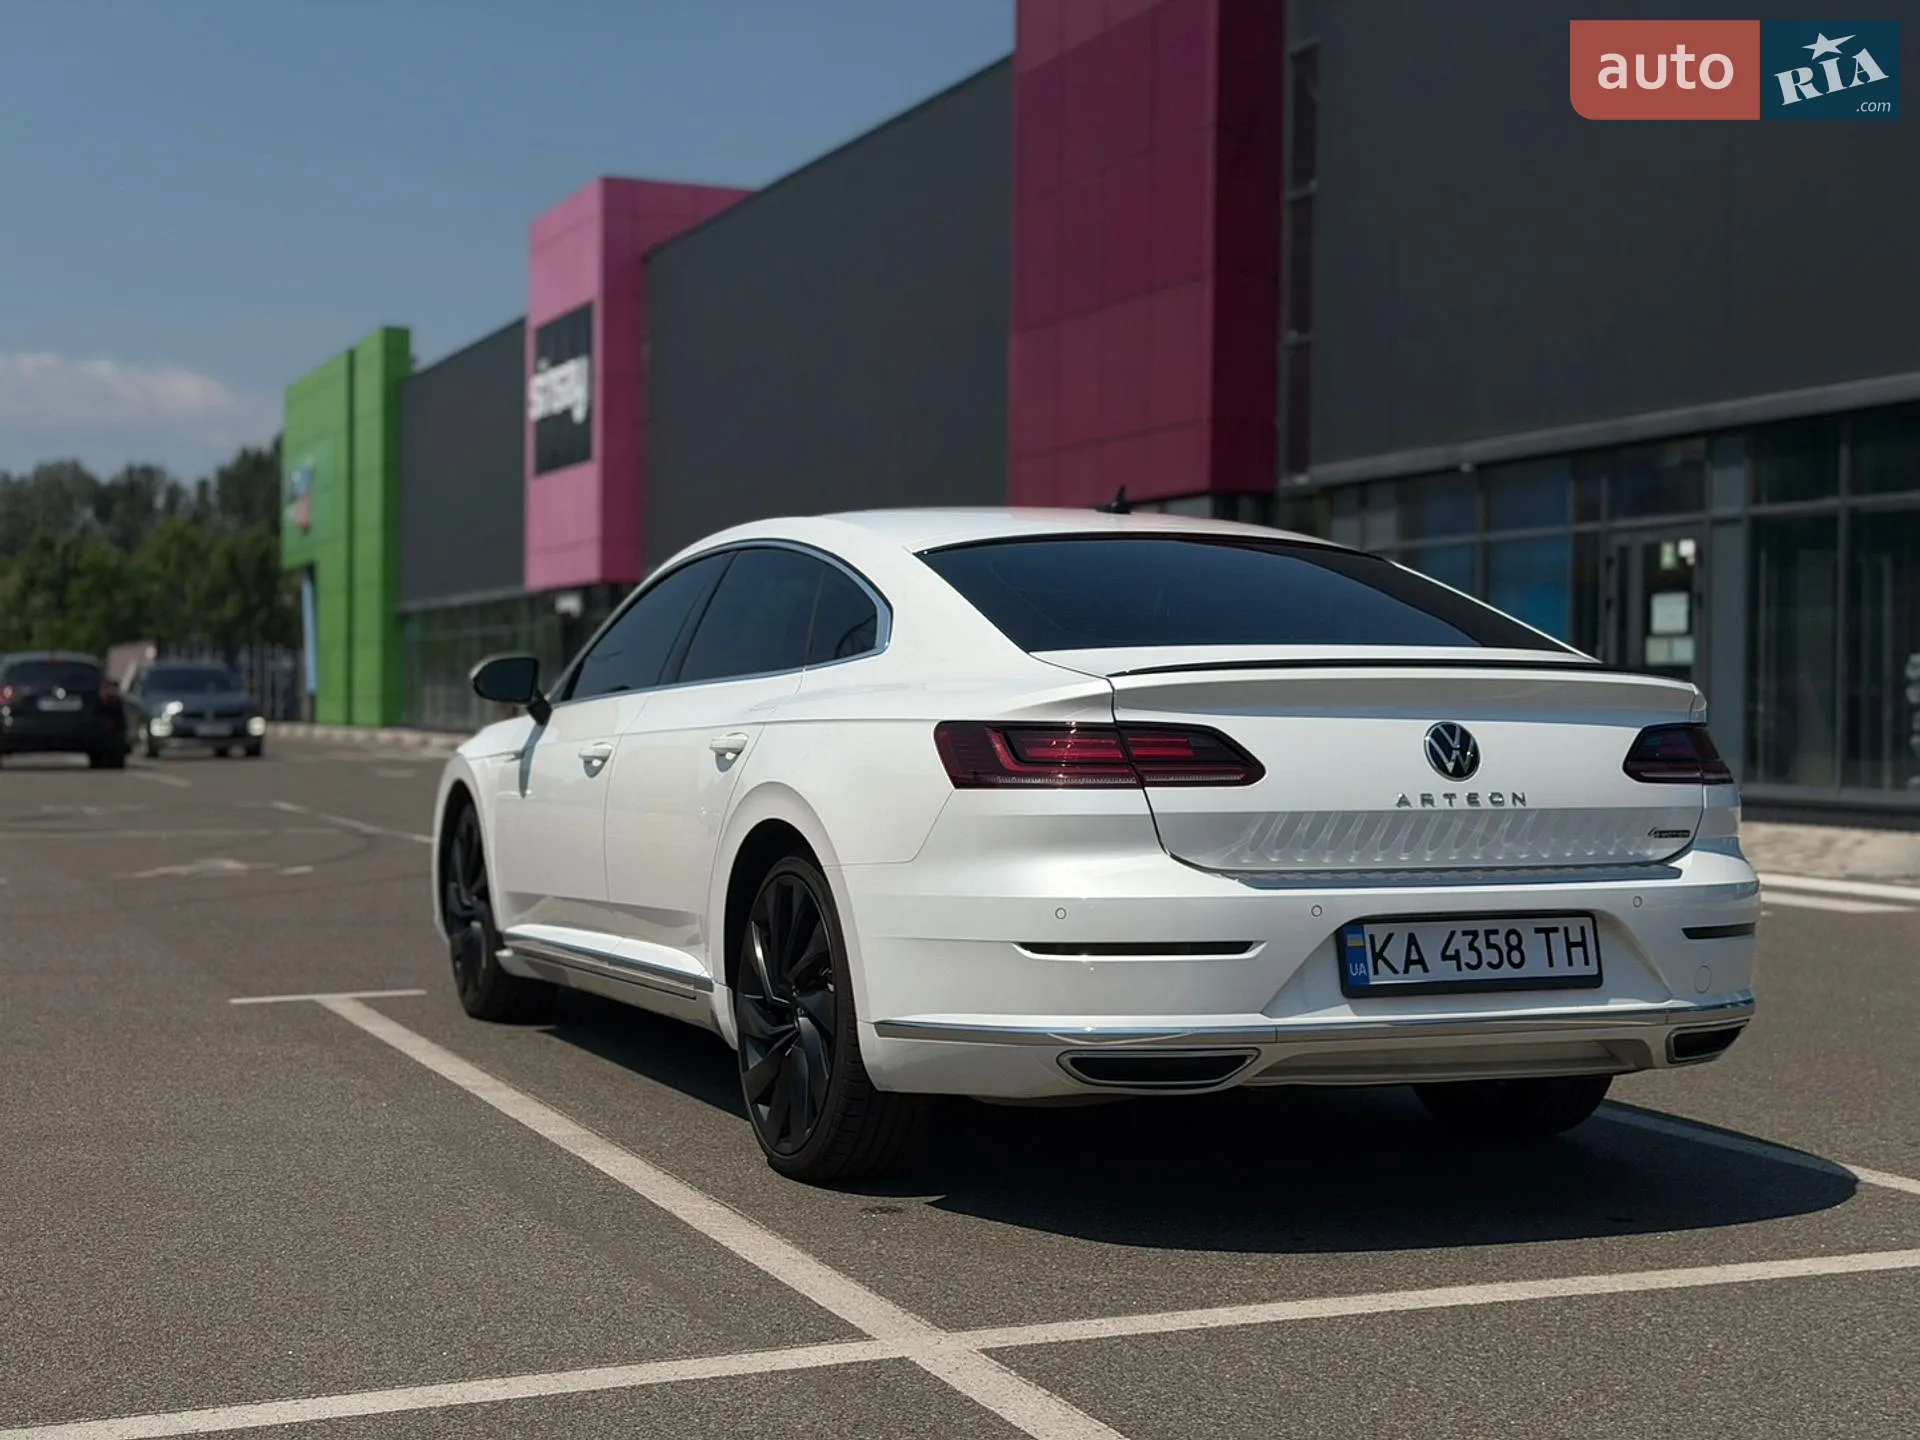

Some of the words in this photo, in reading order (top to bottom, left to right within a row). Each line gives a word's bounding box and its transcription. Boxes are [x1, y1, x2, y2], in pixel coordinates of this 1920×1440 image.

[1395, 791, 1528, 808] ARTEON
[1369, 931, 1430, 976] KA
[1440, 928, 1526, 972] 4358
[1534, 926, 1591, 968] TH
[1349, 962, 1368, 977] UA
